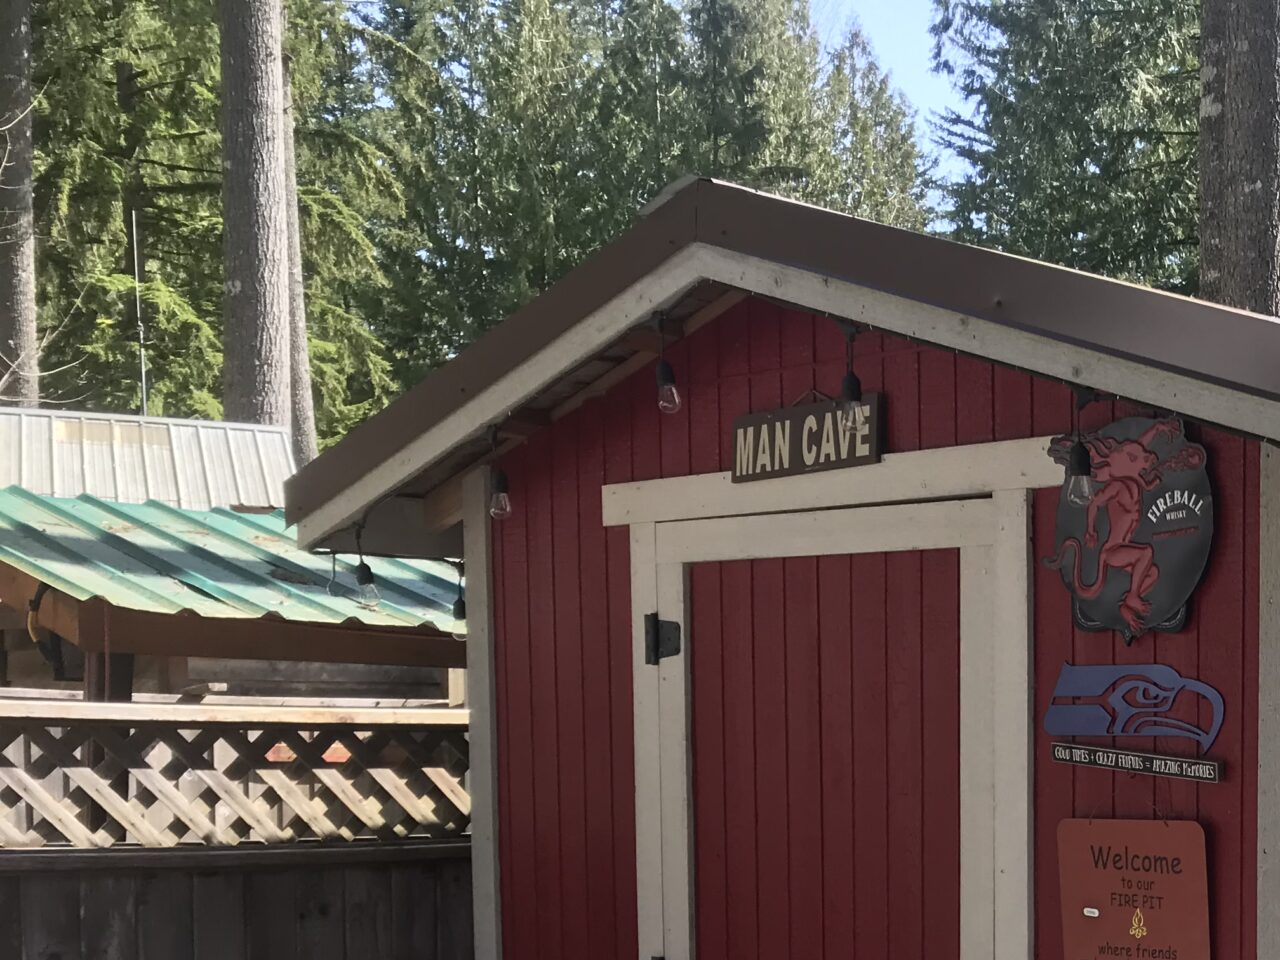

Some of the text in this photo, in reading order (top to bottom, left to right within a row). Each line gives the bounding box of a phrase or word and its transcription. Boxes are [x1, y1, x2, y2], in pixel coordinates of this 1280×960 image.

[736, 405, 870, 476] MAN CAVE
[1147, 490, 1203, 523] FIREBALL
[1165, 509, 1186, 520] WHISKY
[1055, 747, 1070, 760] GOOD
[1072, 749, 1089, 762] TIMES
[1096, 752, 1116, 765] CRAZY
[1118, 754, 1143, 769] FRIENDS
[1153, 760, 1181, 774] AMAZING
[1090, 845, 1183, 874] Welcome
[1121, 877, 1155, 891] to our
[1110, 892, 1164, 910] FIRE PIT
[1098, 942, 1177, 960] where friends
